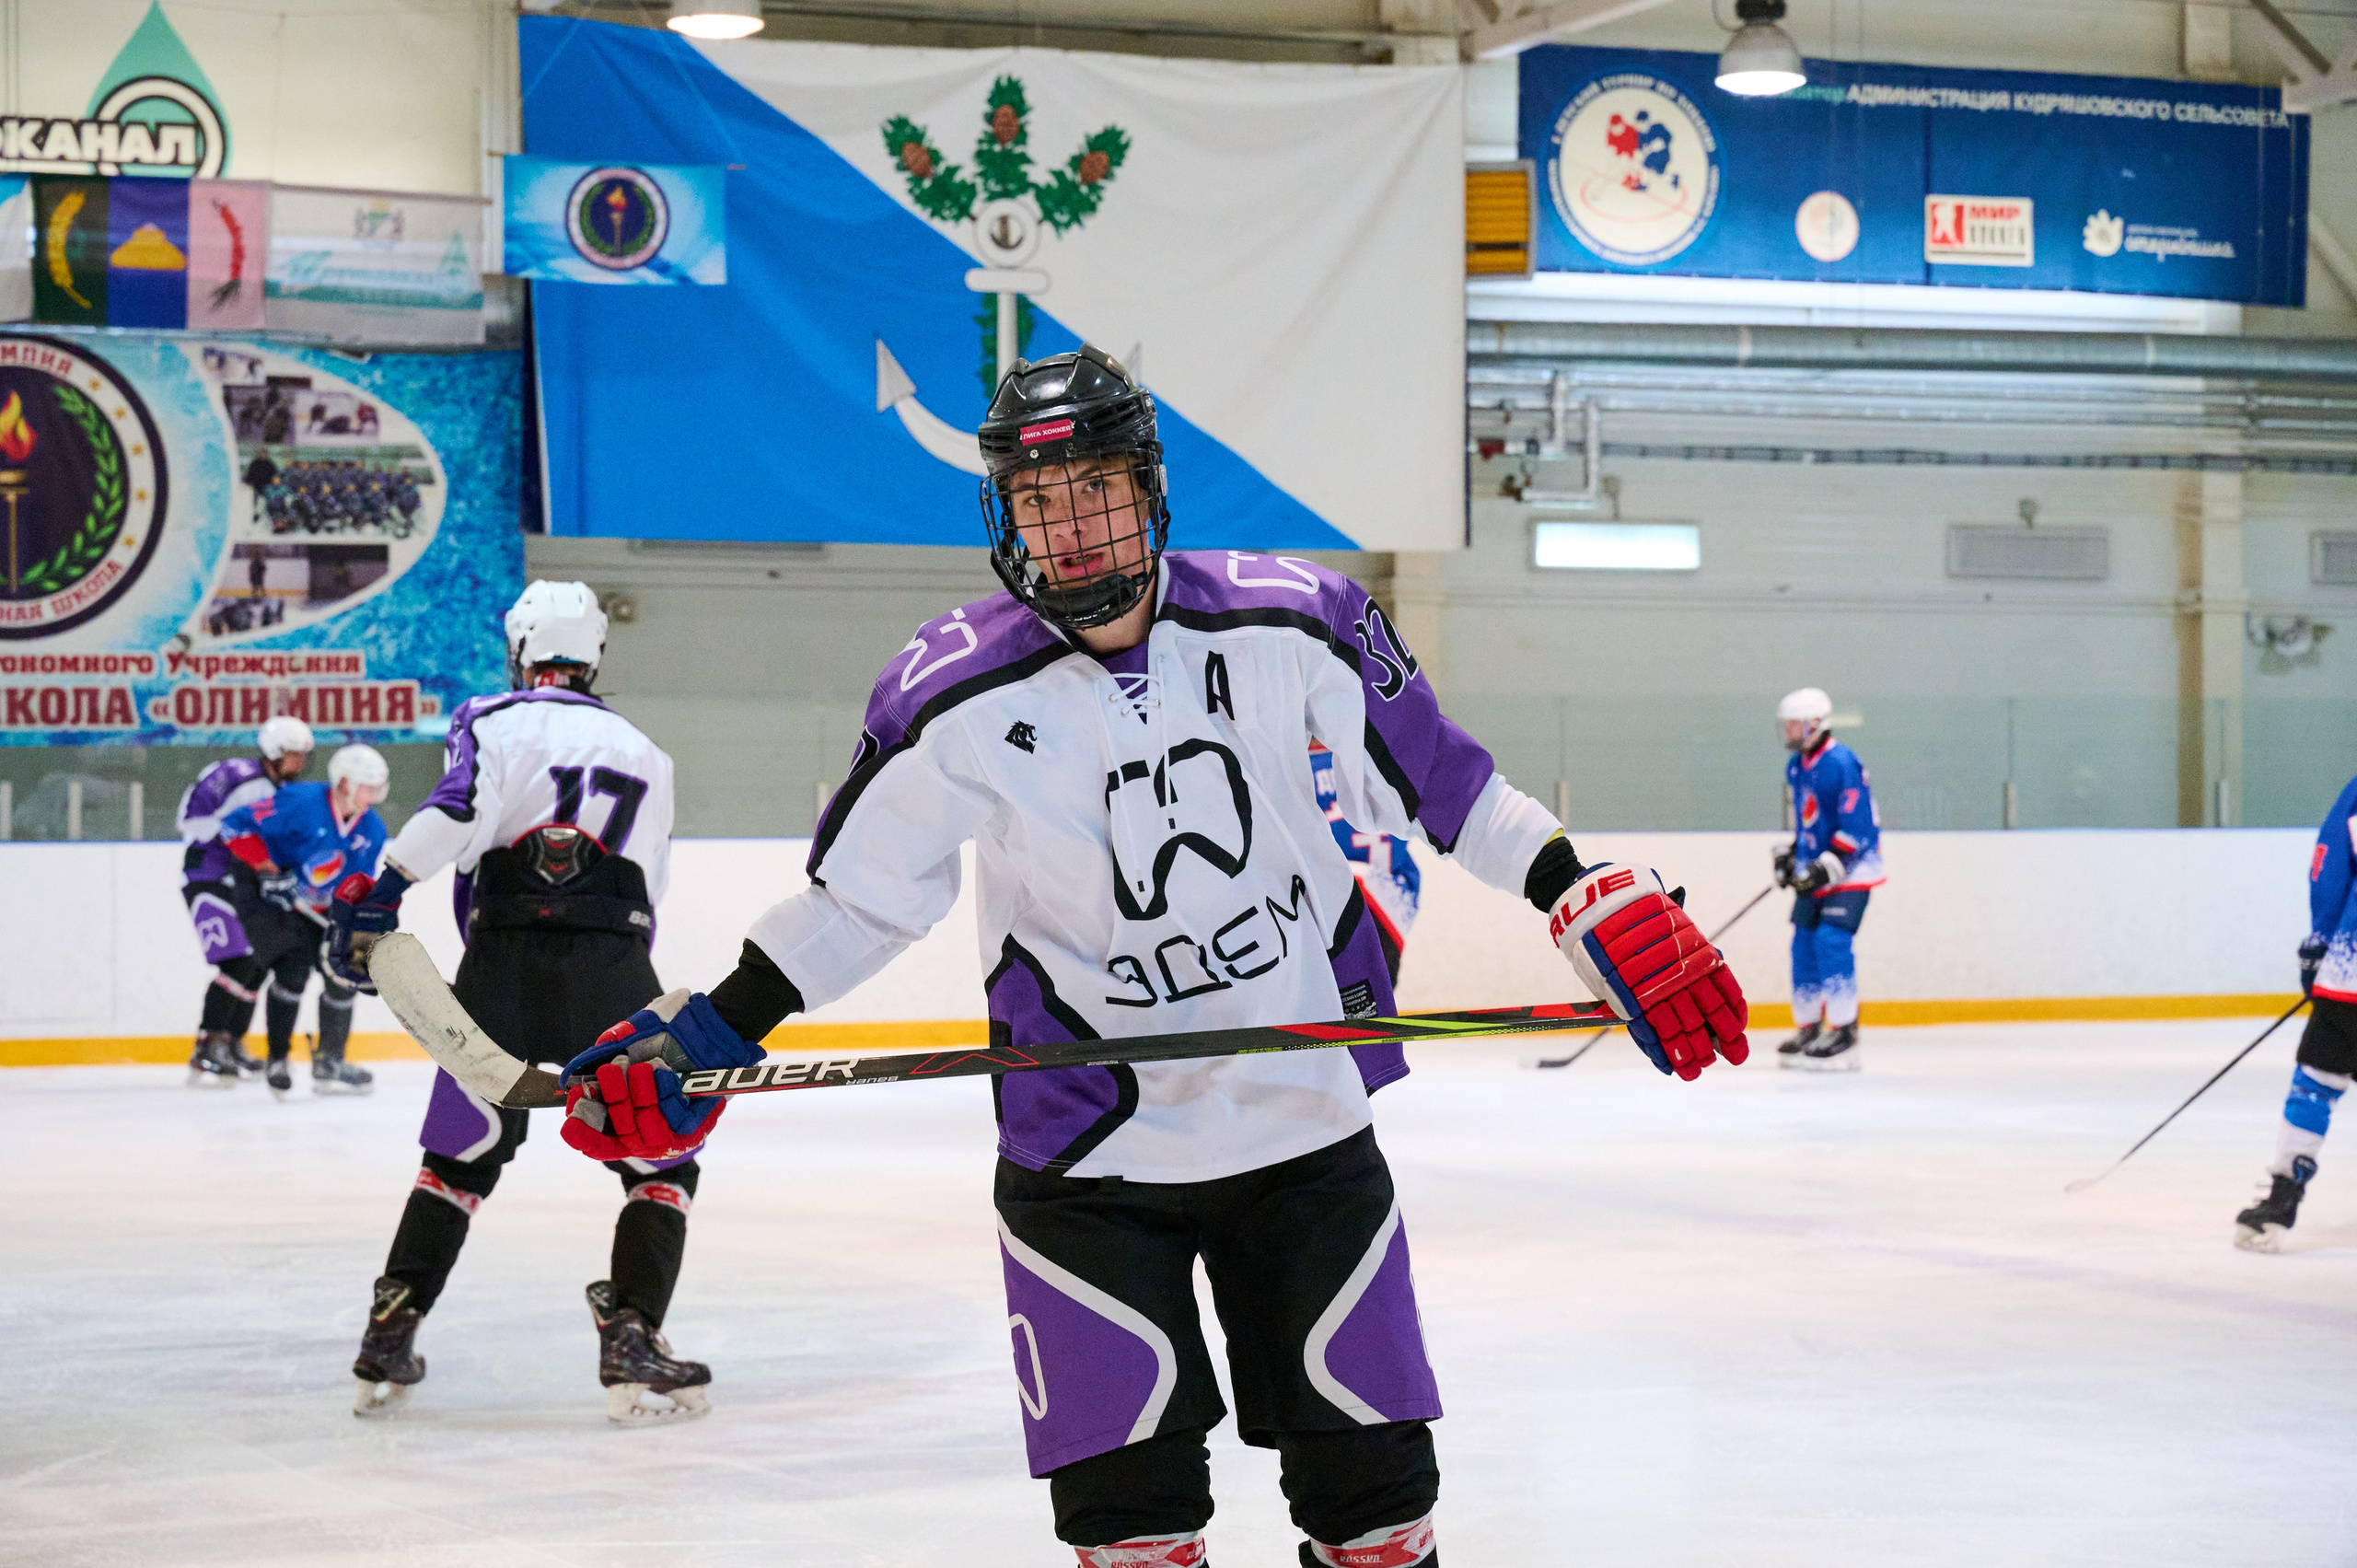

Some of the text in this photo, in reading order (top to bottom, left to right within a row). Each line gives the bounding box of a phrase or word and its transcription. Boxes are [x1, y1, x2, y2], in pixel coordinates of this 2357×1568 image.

[0, 117, 197, 166] КАНАЛ
[1022, 424, 1072, 440] ЛИГА ХОККЕЯ
[51, 559, 122, 617] ШКОЛА
[1353, 597, 1419, 702] 32
[5, 686, 134, 726] КОЛА
[1204, 650, 1235, 721] A
[549, 765, 648, 856] 17
[1106, 874, 1306, 1007] ЭДЕМ
[681, 1058, 861, 1094] AUER
